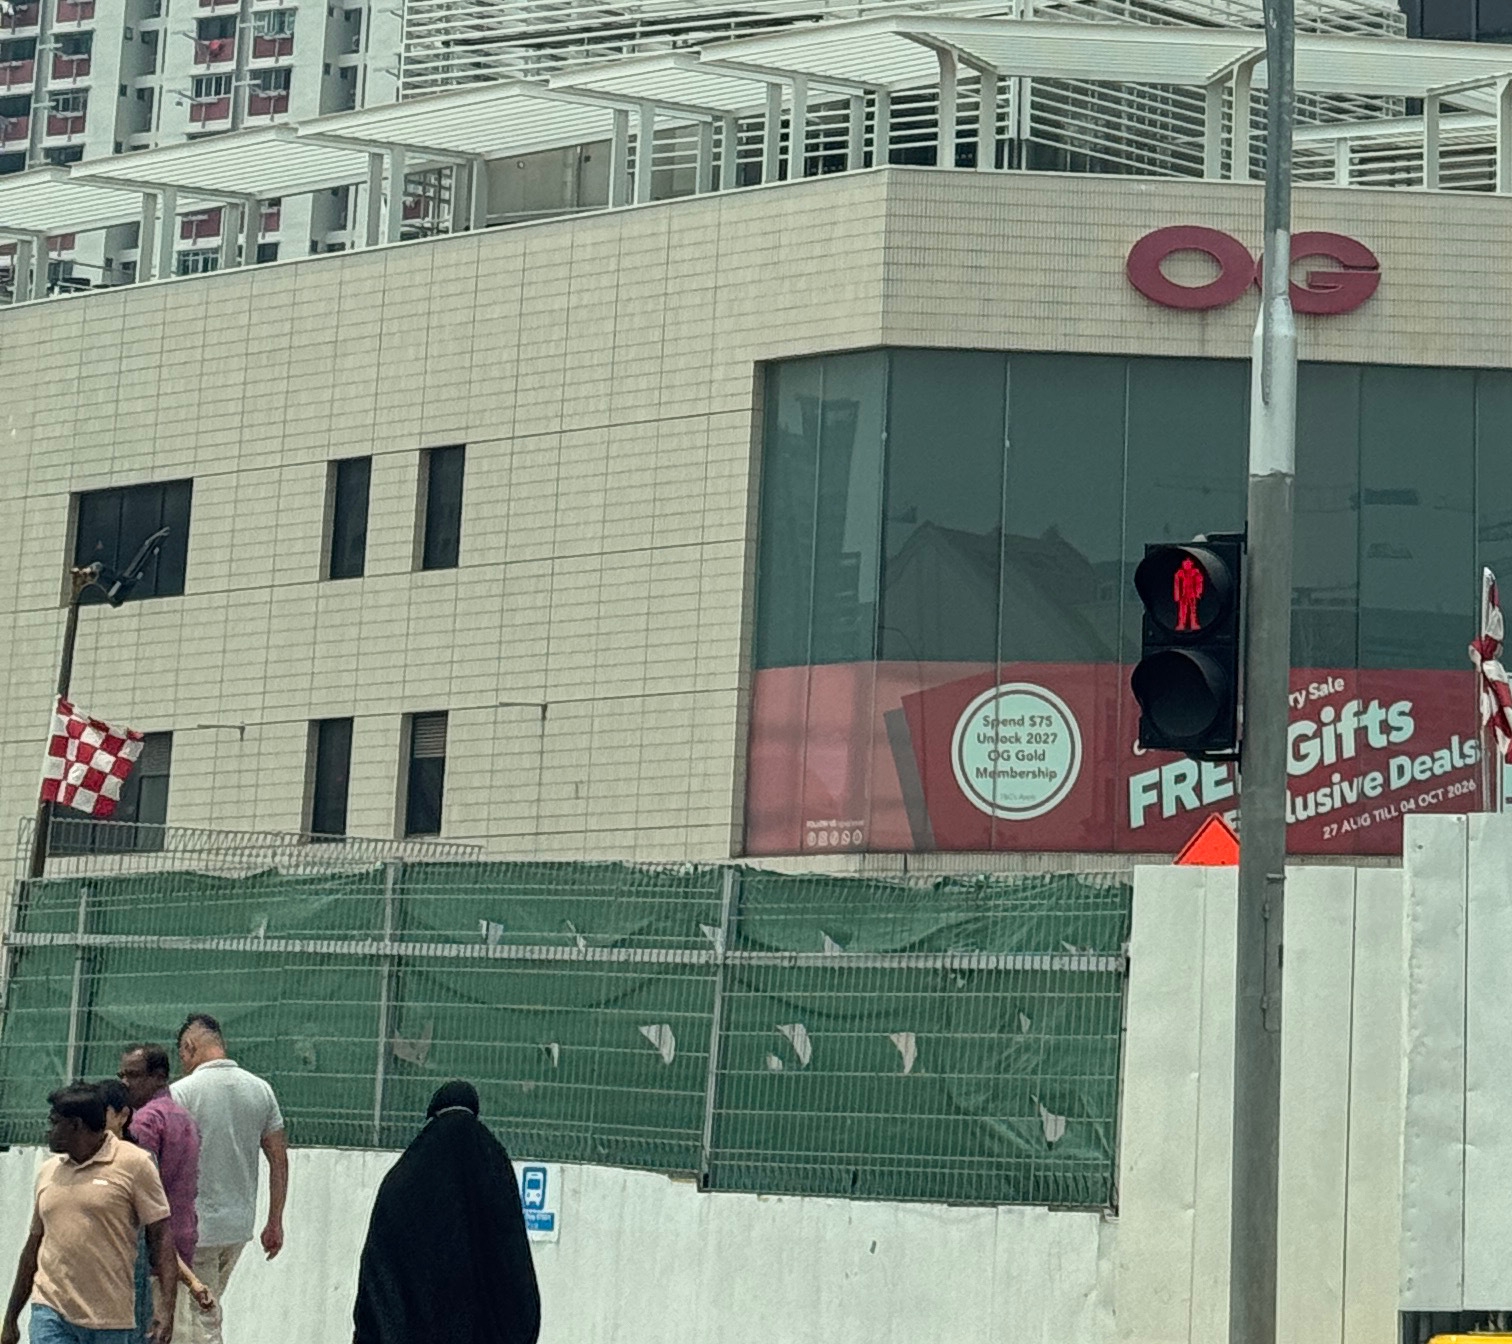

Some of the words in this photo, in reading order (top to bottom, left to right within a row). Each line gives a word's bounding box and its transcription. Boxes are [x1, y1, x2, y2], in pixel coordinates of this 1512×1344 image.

[1126, 224, 1382, 315] OG
[1308, 676, 1345, 700] Sale
[982, 715, 1025, 730] Spend
[1028, 715, 1053, 728] $75
[976, 732, 1022, 745] Unlock
[1026, 732, 1058, 745] 2027
[987, 749, 1011, 763] OG
[1015, 749, 1046, 762] Gold
[1129, 758, 1241, 829] FRE
[1287, 698, 1415, 776] Gifts
[975, 767, 1058, 782] Membership
[1321, 823, 1338, 840] 27
[1373, 804, 1399, 824] TILL
[1400, 799, 1416, 813] 04
[1418, 788, 1445, 808] OCT
[1446, 779, 1477, 799] 2026
